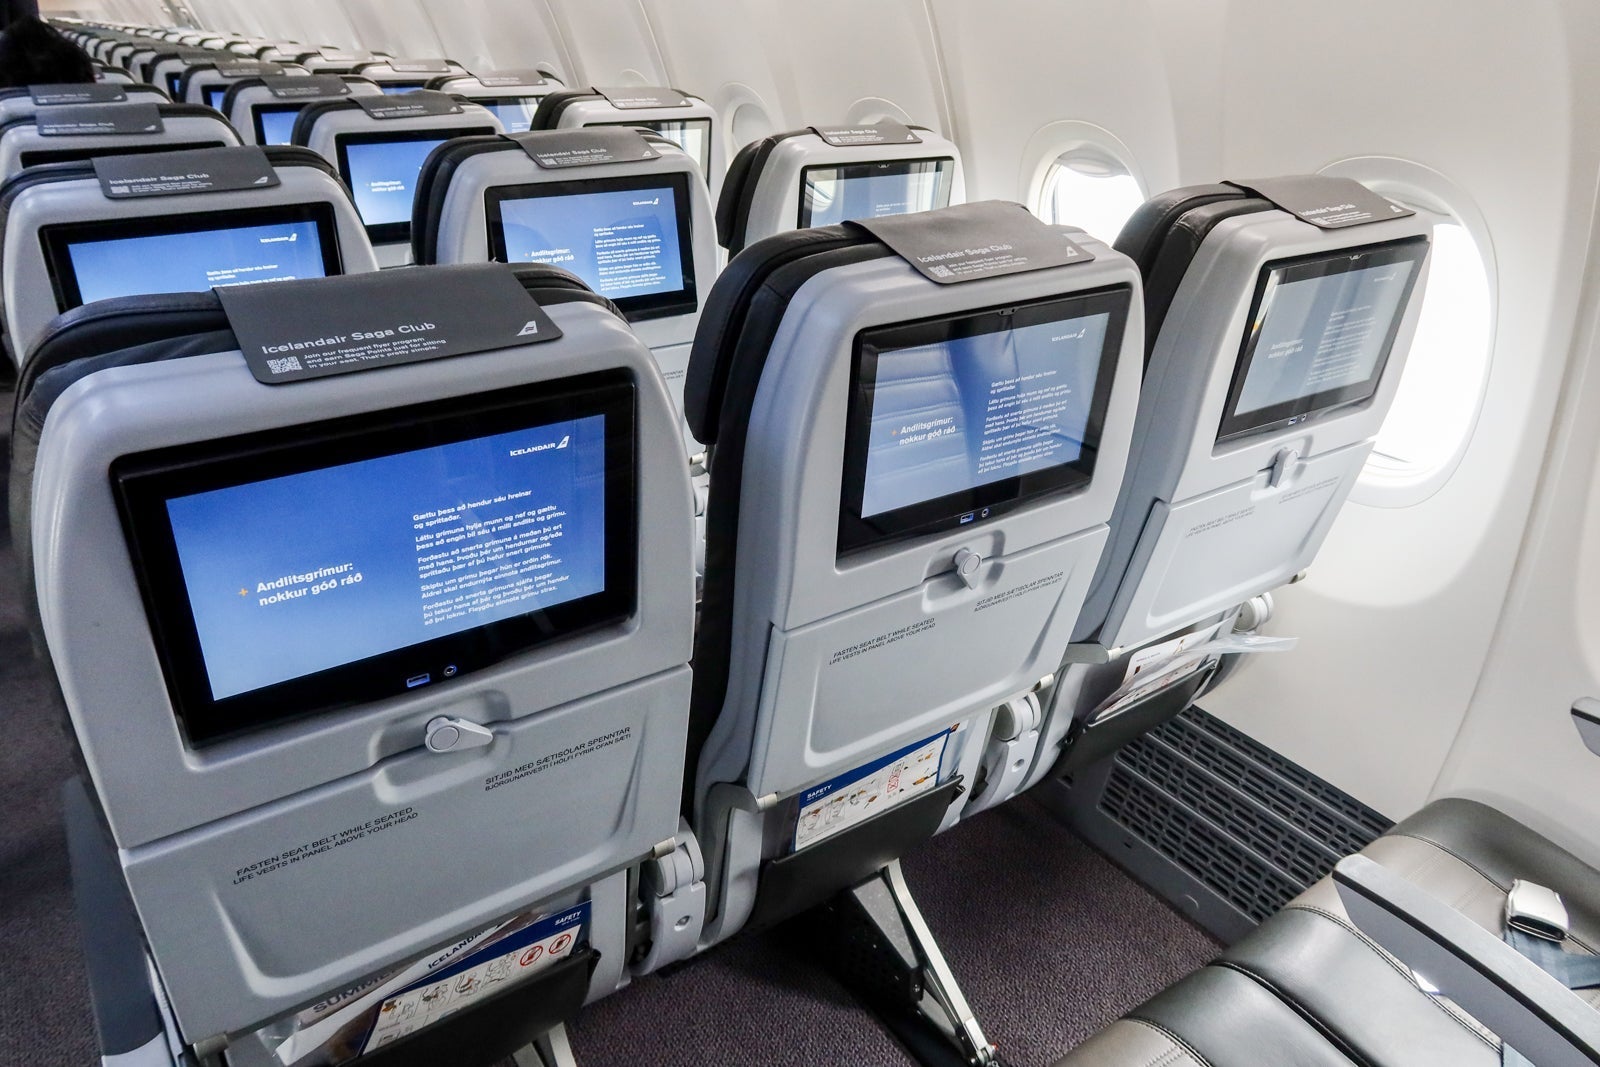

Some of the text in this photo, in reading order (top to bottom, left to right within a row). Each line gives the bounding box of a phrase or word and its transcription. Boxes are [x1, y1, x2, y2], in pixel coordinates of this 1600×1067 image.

[262, 322, 435, 353] Icelandair Saga Club
[338, 345, 372, 353] frequent
[392, 337, 424, 346] program
[510, 442, 555, 456] ICELANDAIR
[413, 512, 436, 521] Gættu
[437, 507, 455, 516] þess
[456, 503, 466, 511] að
[467, 499, 492, 508] hendur
[483, 518, 503, 526] munn
[537, 505, 556, 514] gættu
[416, 542, 433, 551] þess
[446, 534, 465, 543] engin
[461, 544, 482, 552] snerta
[519, 529, 541, 538] meðan
[418, 562, 434, 570] með
[257, 563, 352, 592] Andlitsgrímur:
[421, 582, 443, 591] Skiptu
[479, 568, 498, 577] þegar
[534, 573, 552, 581] þegar
[547, 575, 569, 584] hendur
[259, 572, 362, 605] nokkur góð ráð
[443, 585, 457, 593] skal
[833, 645, 858, 658] FASTEN
[587, 727, 630, 746] SPENNTAR
[806, 784, 832, 798] SAFETY
[233, 873, 253, 884] LIFE
[256, 860, 287, 875] VESTS
[302, 845, 332, 859] PANEL
[334, 831, 364, 847] ABOVE
[367, 821, 392, 834] YOUR
[394, 812, 418, 824] HEAD
[236, 807, 412, 876] FASTEN SEAT BELT WHILE SEATED
[555, 910, 581, 925] SAFETY
